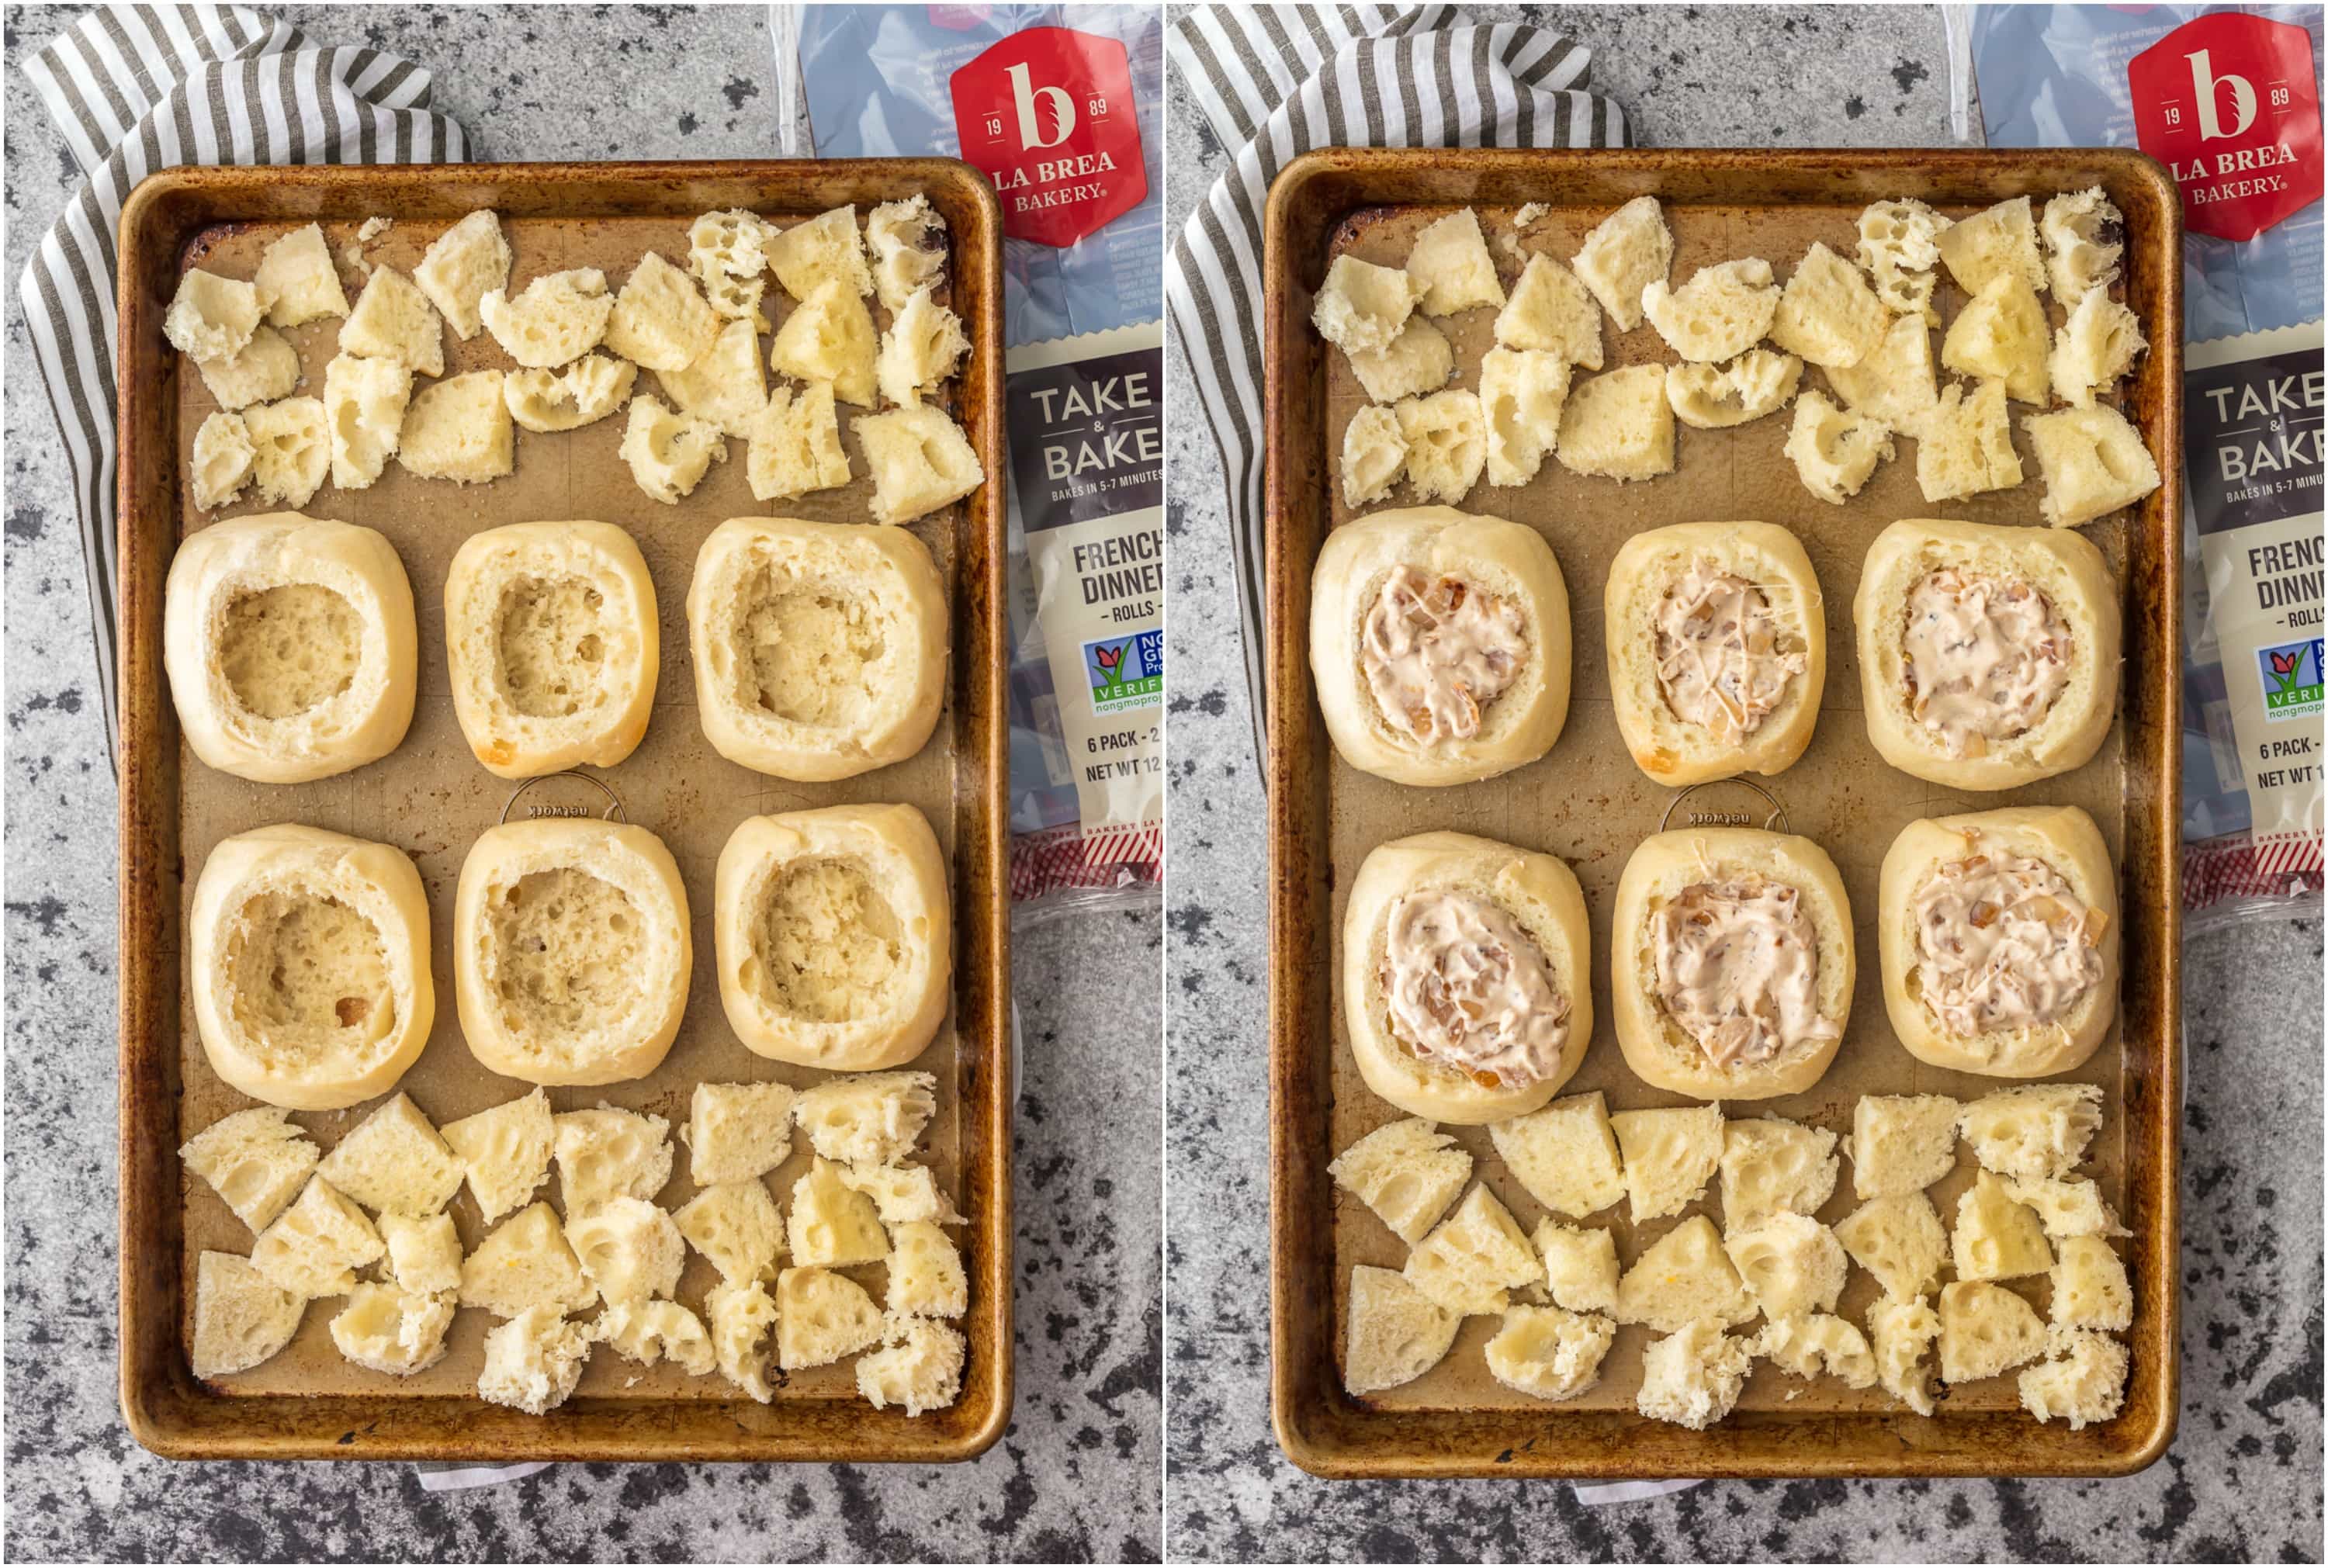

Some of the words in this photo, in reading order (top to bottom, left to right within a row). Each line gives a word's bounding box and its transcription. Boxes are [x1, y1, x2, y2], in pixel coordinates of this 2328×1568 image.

[1003, 62, 1076, 152] b
[2164, 108, 2181, 125] 19
[2271, 88, 2289, 106] 89
[2184, 48, 2257, 142] b
[987, 119, 1002, 137] 19
[1089, 99, 1107, 117] 89
[993, 163, 1031, 192] LA
[1038, 151, 1117, 183] BREA
[2170, 159, 2209, 182] LA
[2216, 142, 2299, 175] BREA
[1031, 372, 1152, 424] TAKE
[2205, 371, 2324, 423] TAKE
[1093, 421, 1104, 432] &
[2270, 420, 2281, 432] &
[1043, 427, 1162, 480] BAKE
[1051, 486, 1084, 502] BAKES
[1086, 483, 1097, 494] IN
[1100, 479, 1117, 491] 5-7
[1119, 469, 1162, 486] MINUTES
[2226, 486, 2260, 503] BAKES
[2262, 484, 2273, 496] IN
[2277, 480, 2292, 493] 5-7
[1073, 528, 1162, 573] FRENCH
[1112, 601, 1155, 623] ROLLS
[1099, 678, 1162, 699] VERIF
[1087, 738, 1096, 753] 6
[1100, 730, 1138, 751] PACK
[1150, 727, 1160, 742] 2
[2260, 744, 2269, 760] 6
[2272, 737, 2312, 757] PACK
[1086, 763, 1112, 782] NET
[1116, 759, 1139, 777] WT
[1143, 756, 1162, 773] 12
[2257, 770, 2285, 789] NET
[2288, 766, 2312, 784] WT
[528, 805, 590, 819] network
[1689, 812, 1751, 826] network
